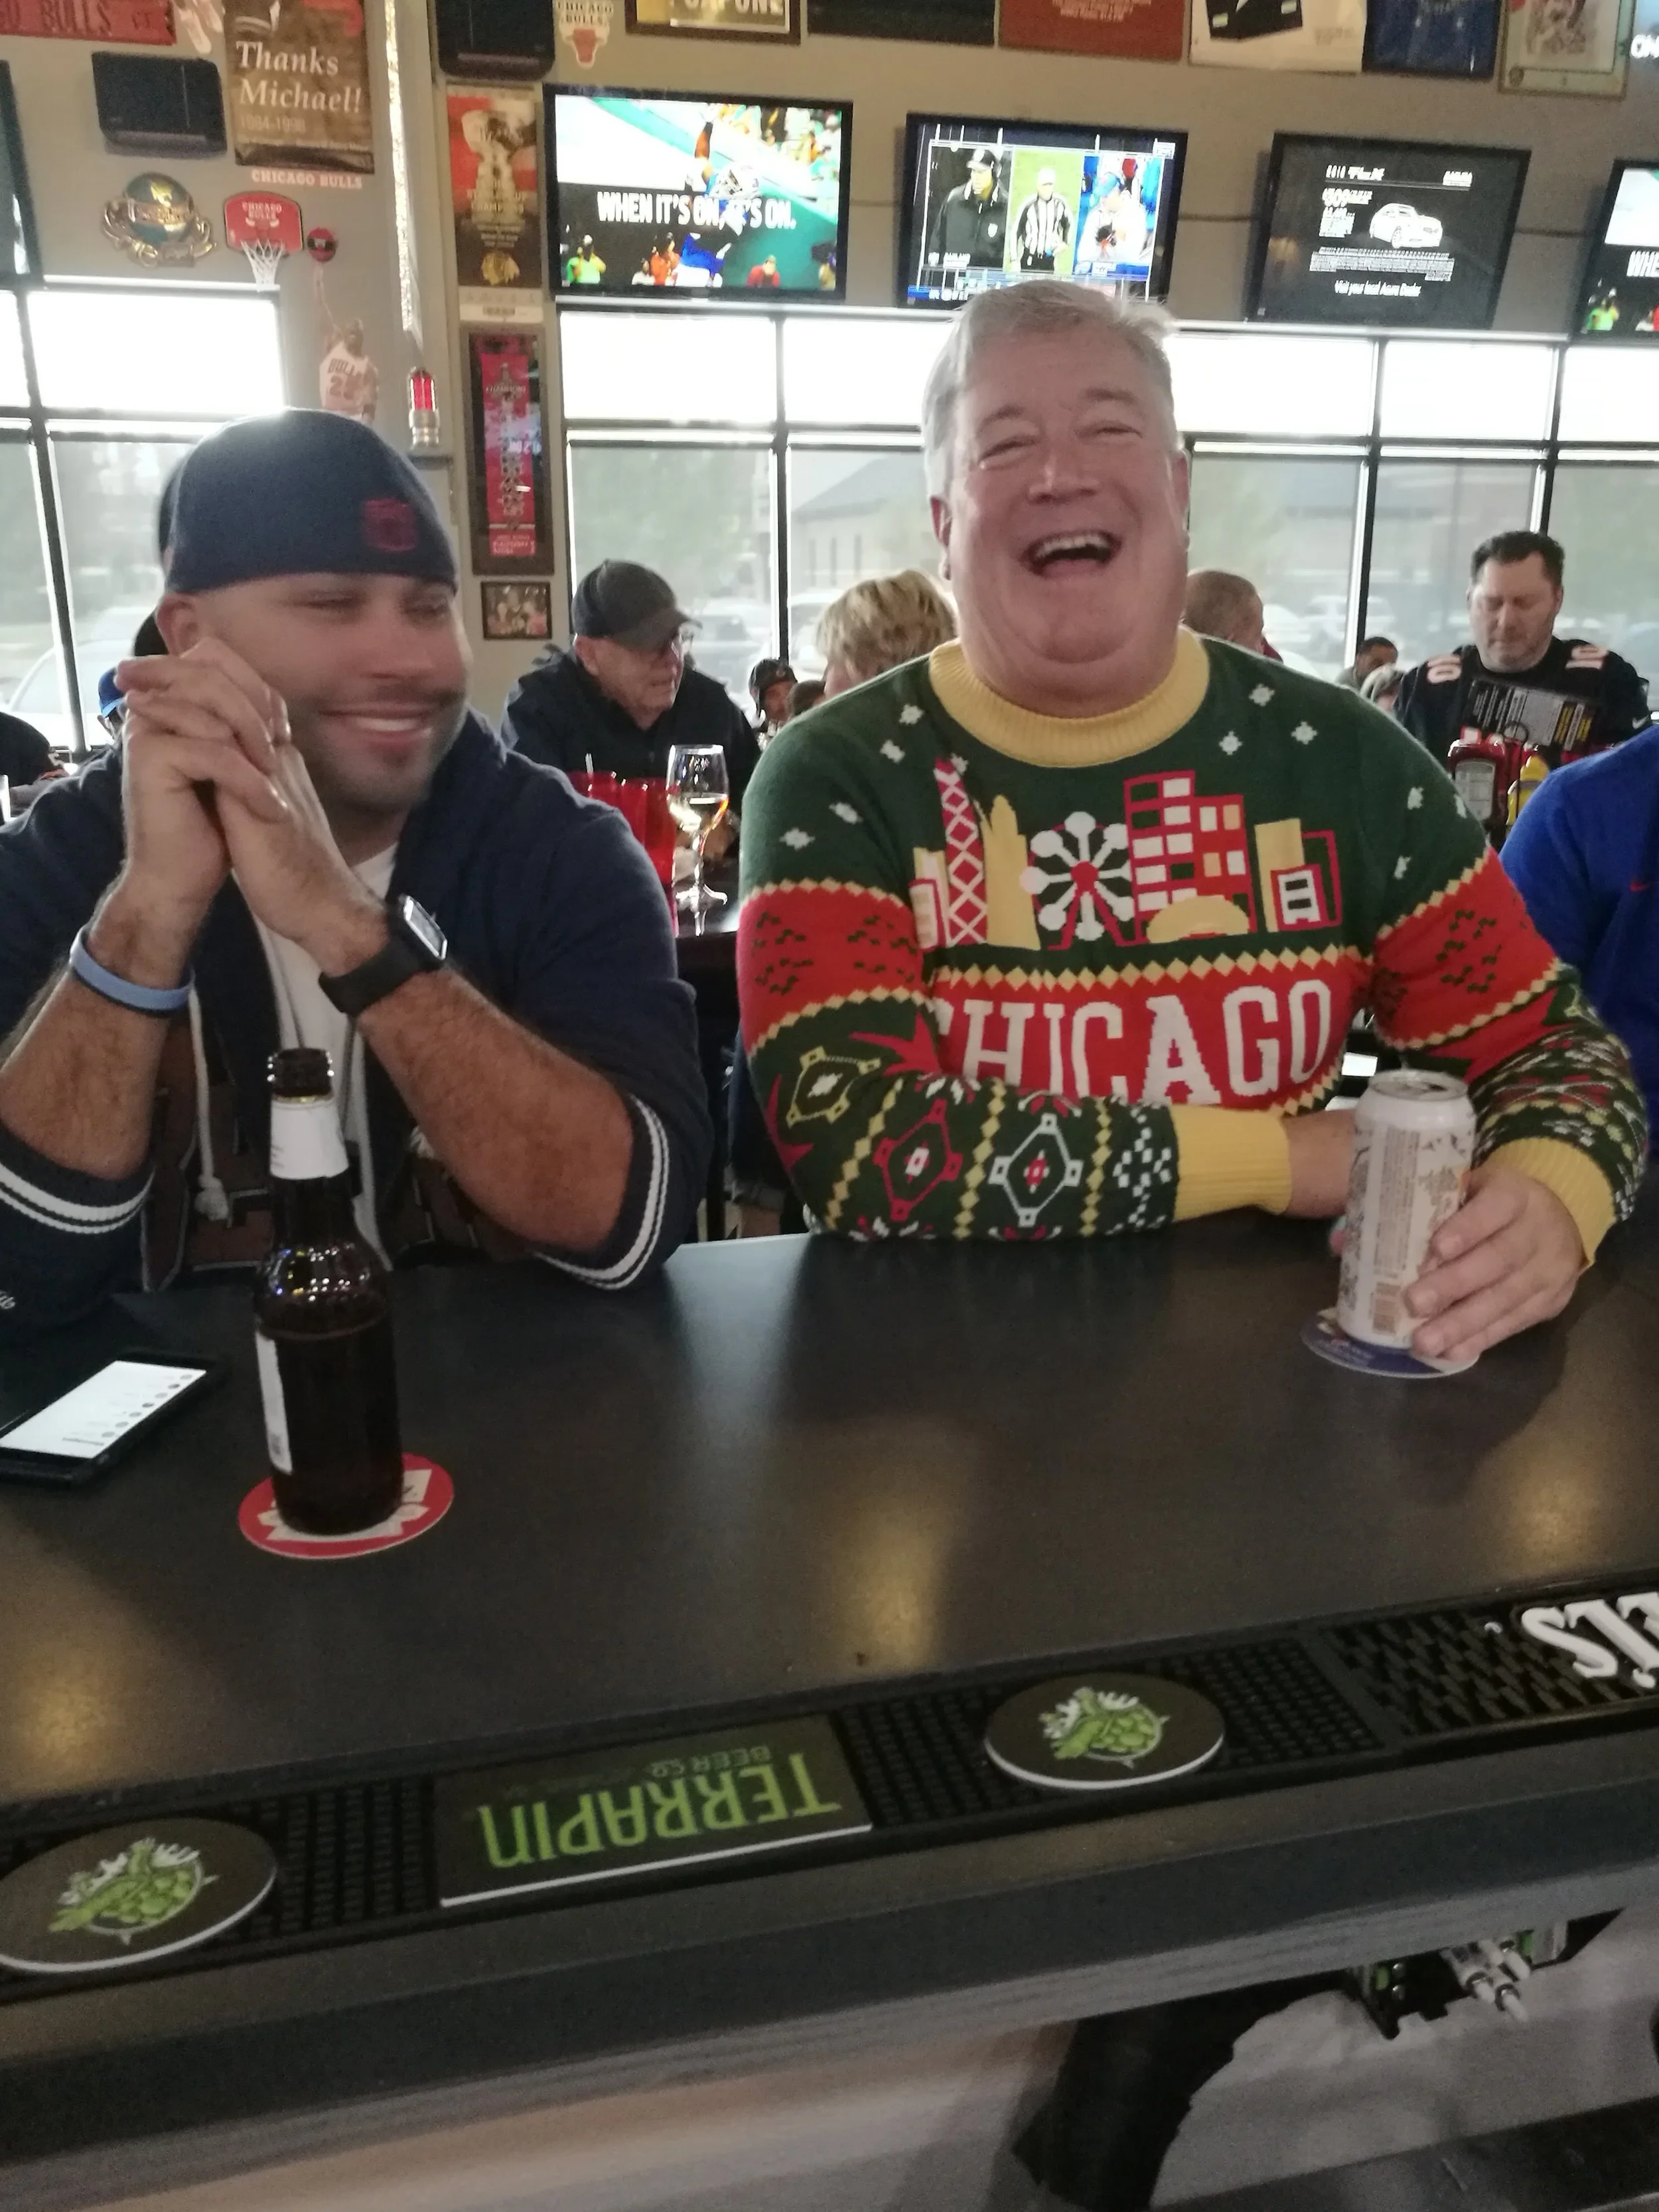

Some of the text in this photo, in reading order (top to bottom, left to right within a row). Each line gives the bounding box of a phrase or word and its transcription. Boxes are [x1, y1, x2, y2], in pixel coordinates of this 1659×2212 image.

[236, 40, 339, 76] Thanks
[239, 78, 362, 113] Michael!
[251, 167, 363, 190] CHICAGO BULLS
[597, 191, 653, 224] WHEN
[656, 194, 691, 224] IT'S
[693, 196, 726, 231] ON,
[764, 199, 796, 230] ON.
[477, 1752, 842, 1868] TERRAPIN
